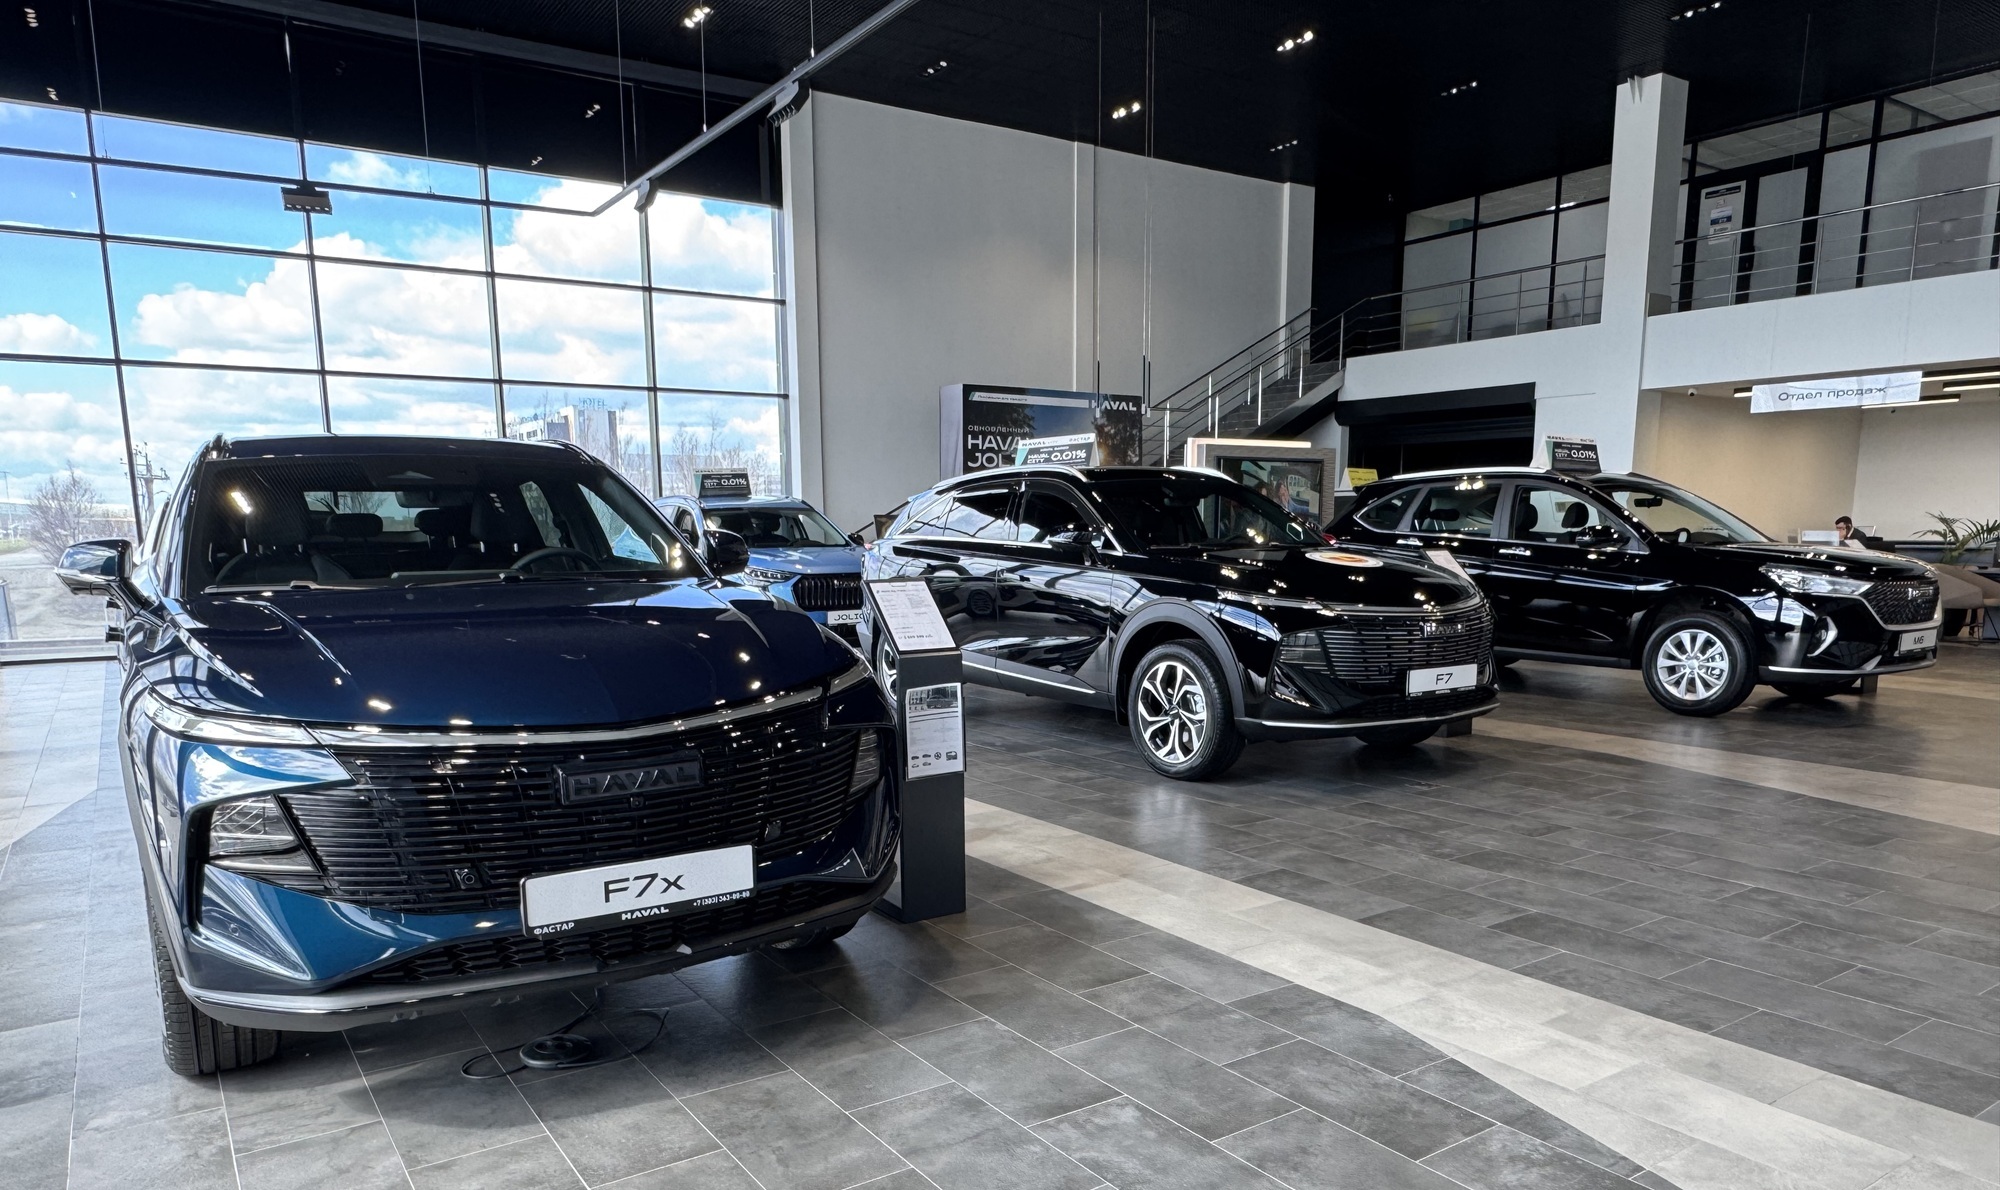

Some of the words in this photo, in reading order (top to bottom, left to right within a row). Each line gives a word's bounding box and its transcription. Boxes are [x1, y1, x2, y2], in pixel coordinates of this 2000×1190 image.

[1778, 391, 1822, 402] Отдел
[1827, 386, 1887, 399] продаж
[1091, 399, 1137, 411] HAVAL
[967, 434, 1020, 450] HAVA
[1050, 449, 1087, 461] 0.01%
[1571, 449, 1597, 459] 0.01%
[721, 478, 747, 486] 0.01%
[1435, 672, 1453, 685] F7
[572, 766, 697, 796] HAVAL
[603, 872, 686, 903] F7x
[621, 906, 669, 921] HAVAL
[533, 922, 575, 935] ФАСТАР
